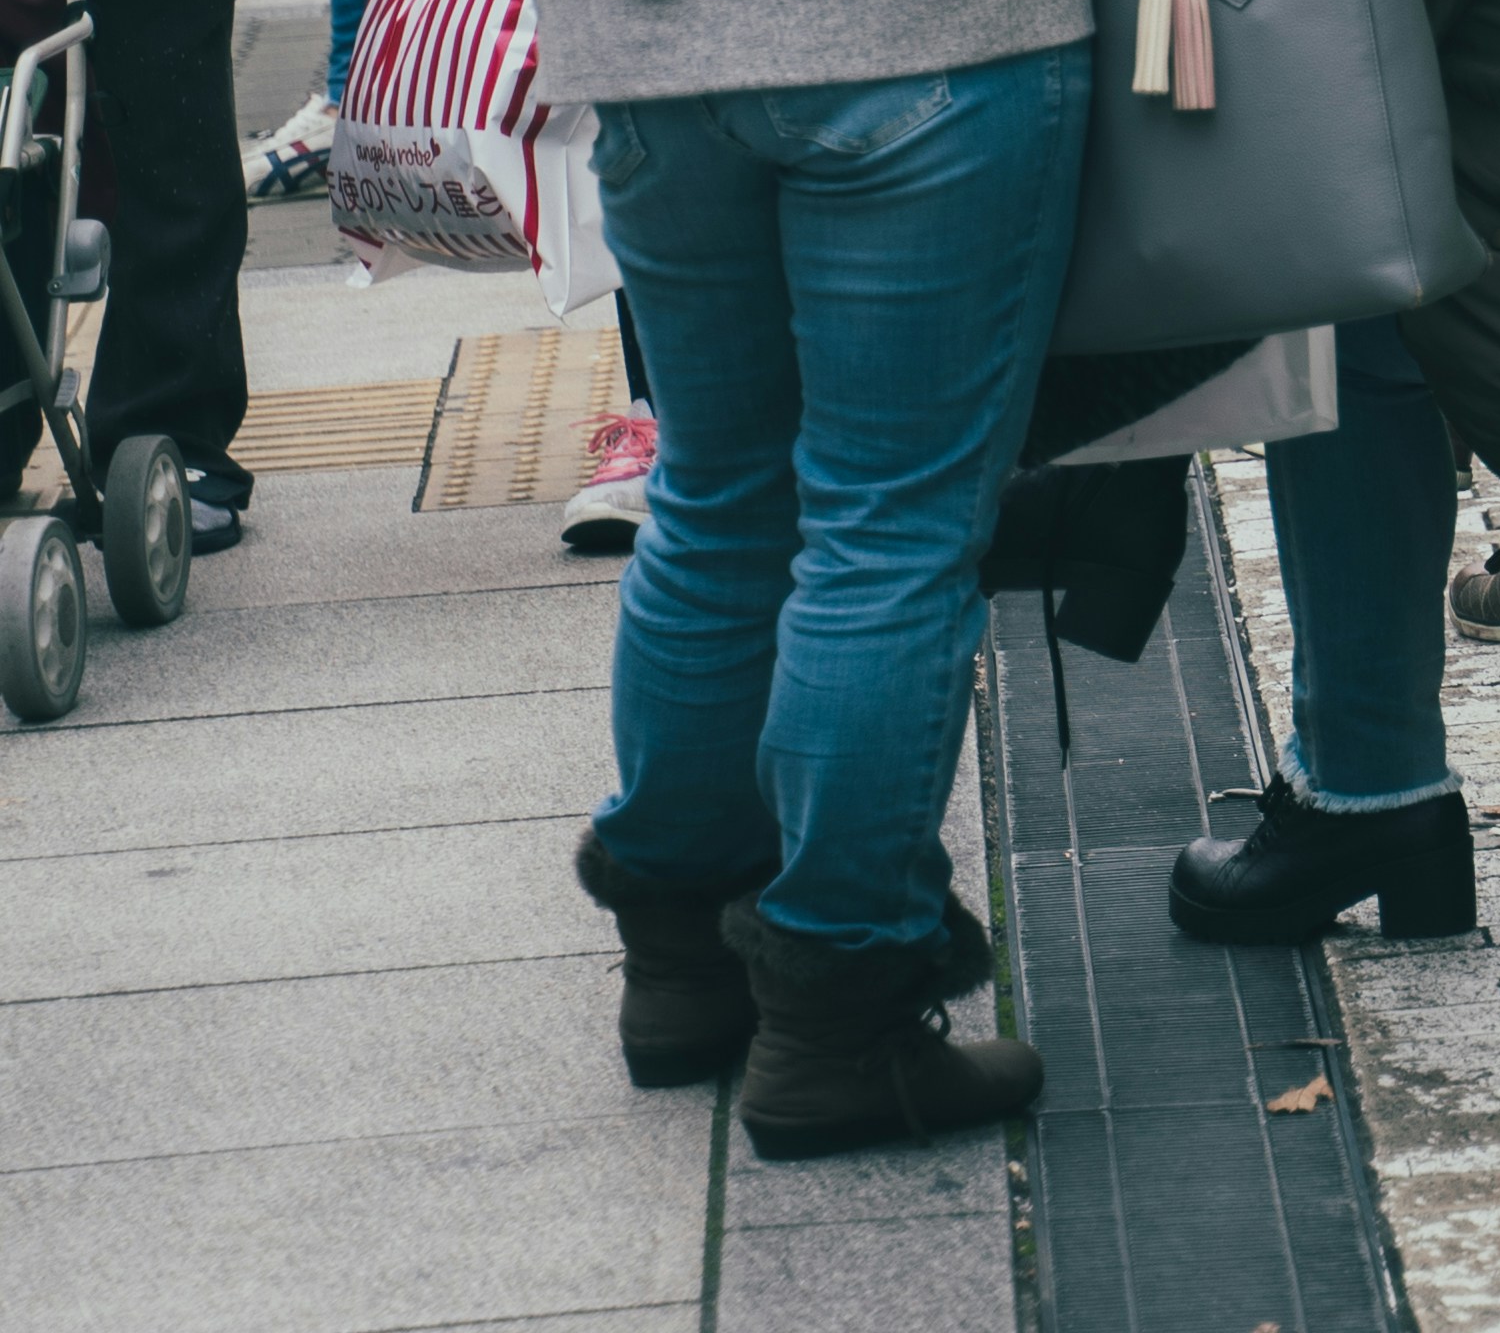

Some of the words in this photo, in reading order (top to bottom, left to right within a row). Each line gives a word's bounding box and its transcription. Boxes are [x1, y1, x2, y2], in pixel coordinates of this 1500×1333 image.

[327, 170, 512, 219] 使のドレス屋さ
